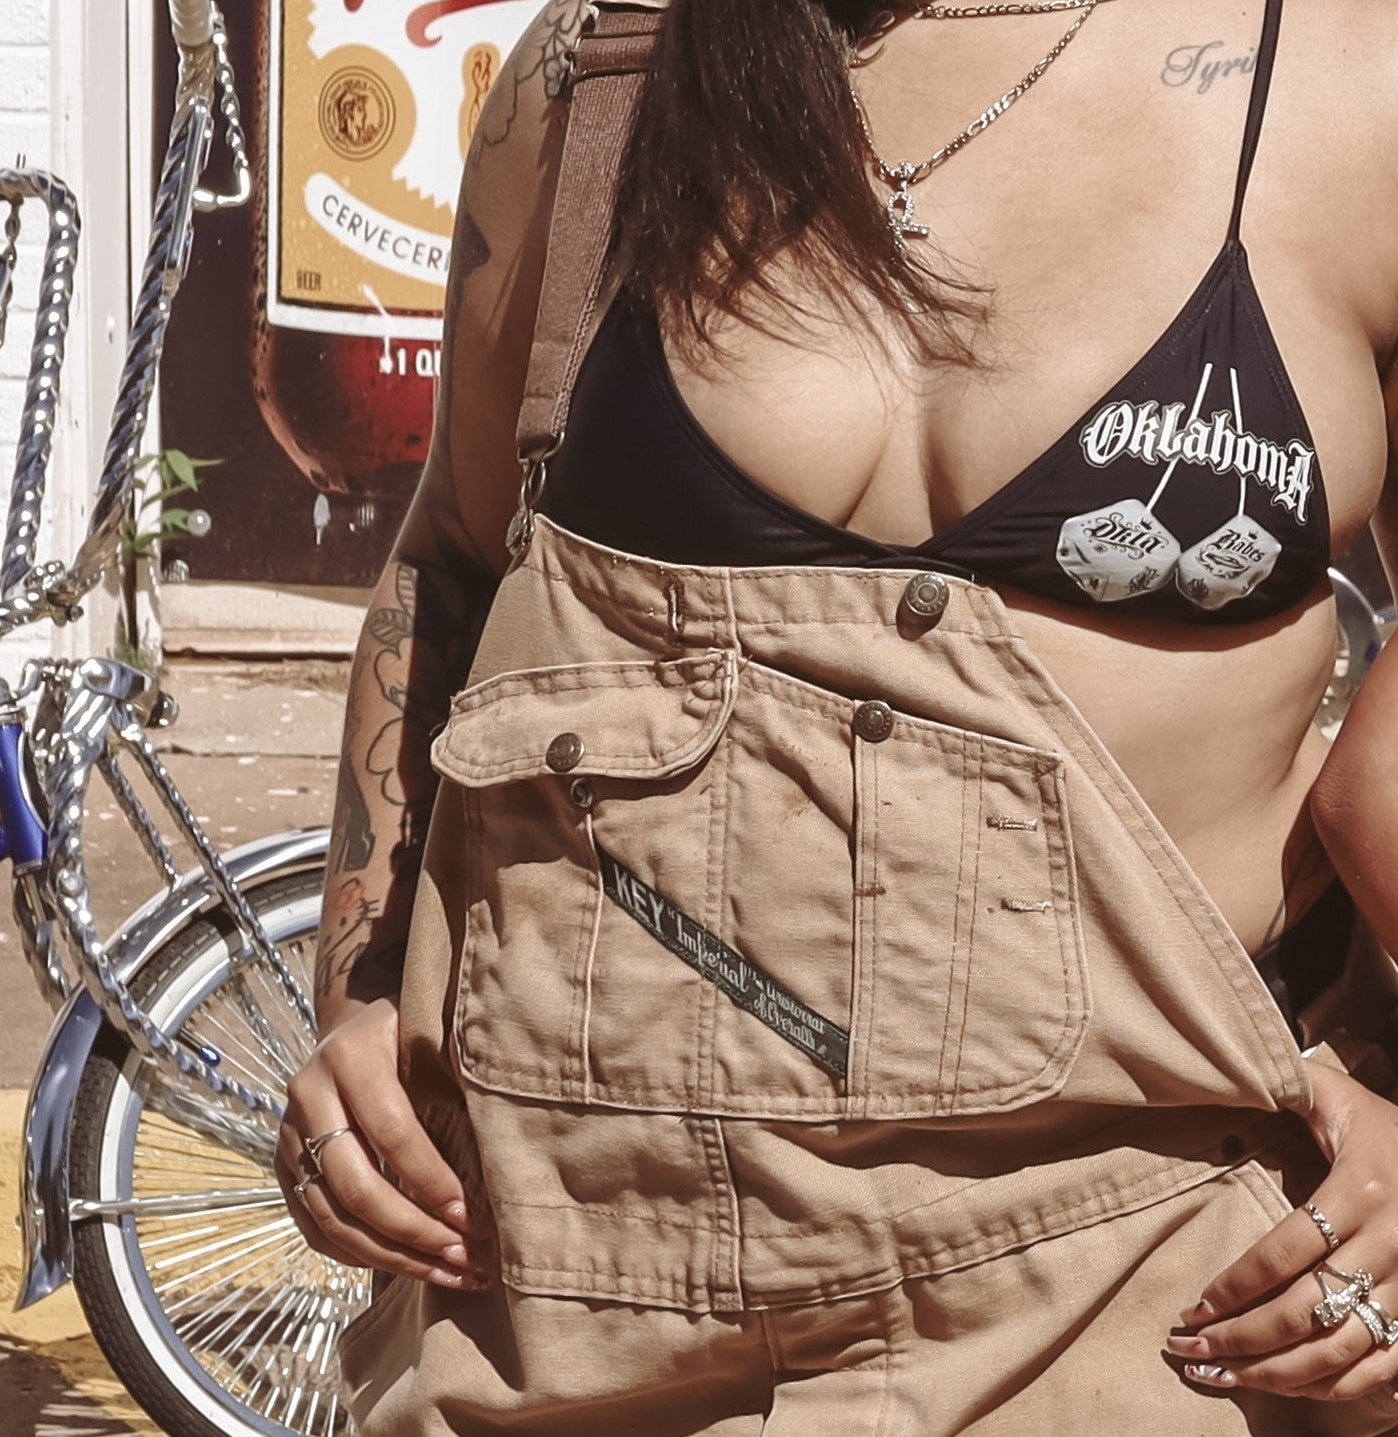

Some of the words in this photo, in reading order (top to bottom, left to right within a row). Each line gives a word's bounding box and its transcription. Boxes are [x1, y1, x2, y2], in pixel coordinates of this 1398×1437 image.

[1161, 40, 1259, 95] Tyri
[296, 268, 321, 292] BEER
[613, 862, 666, 935] KEY
